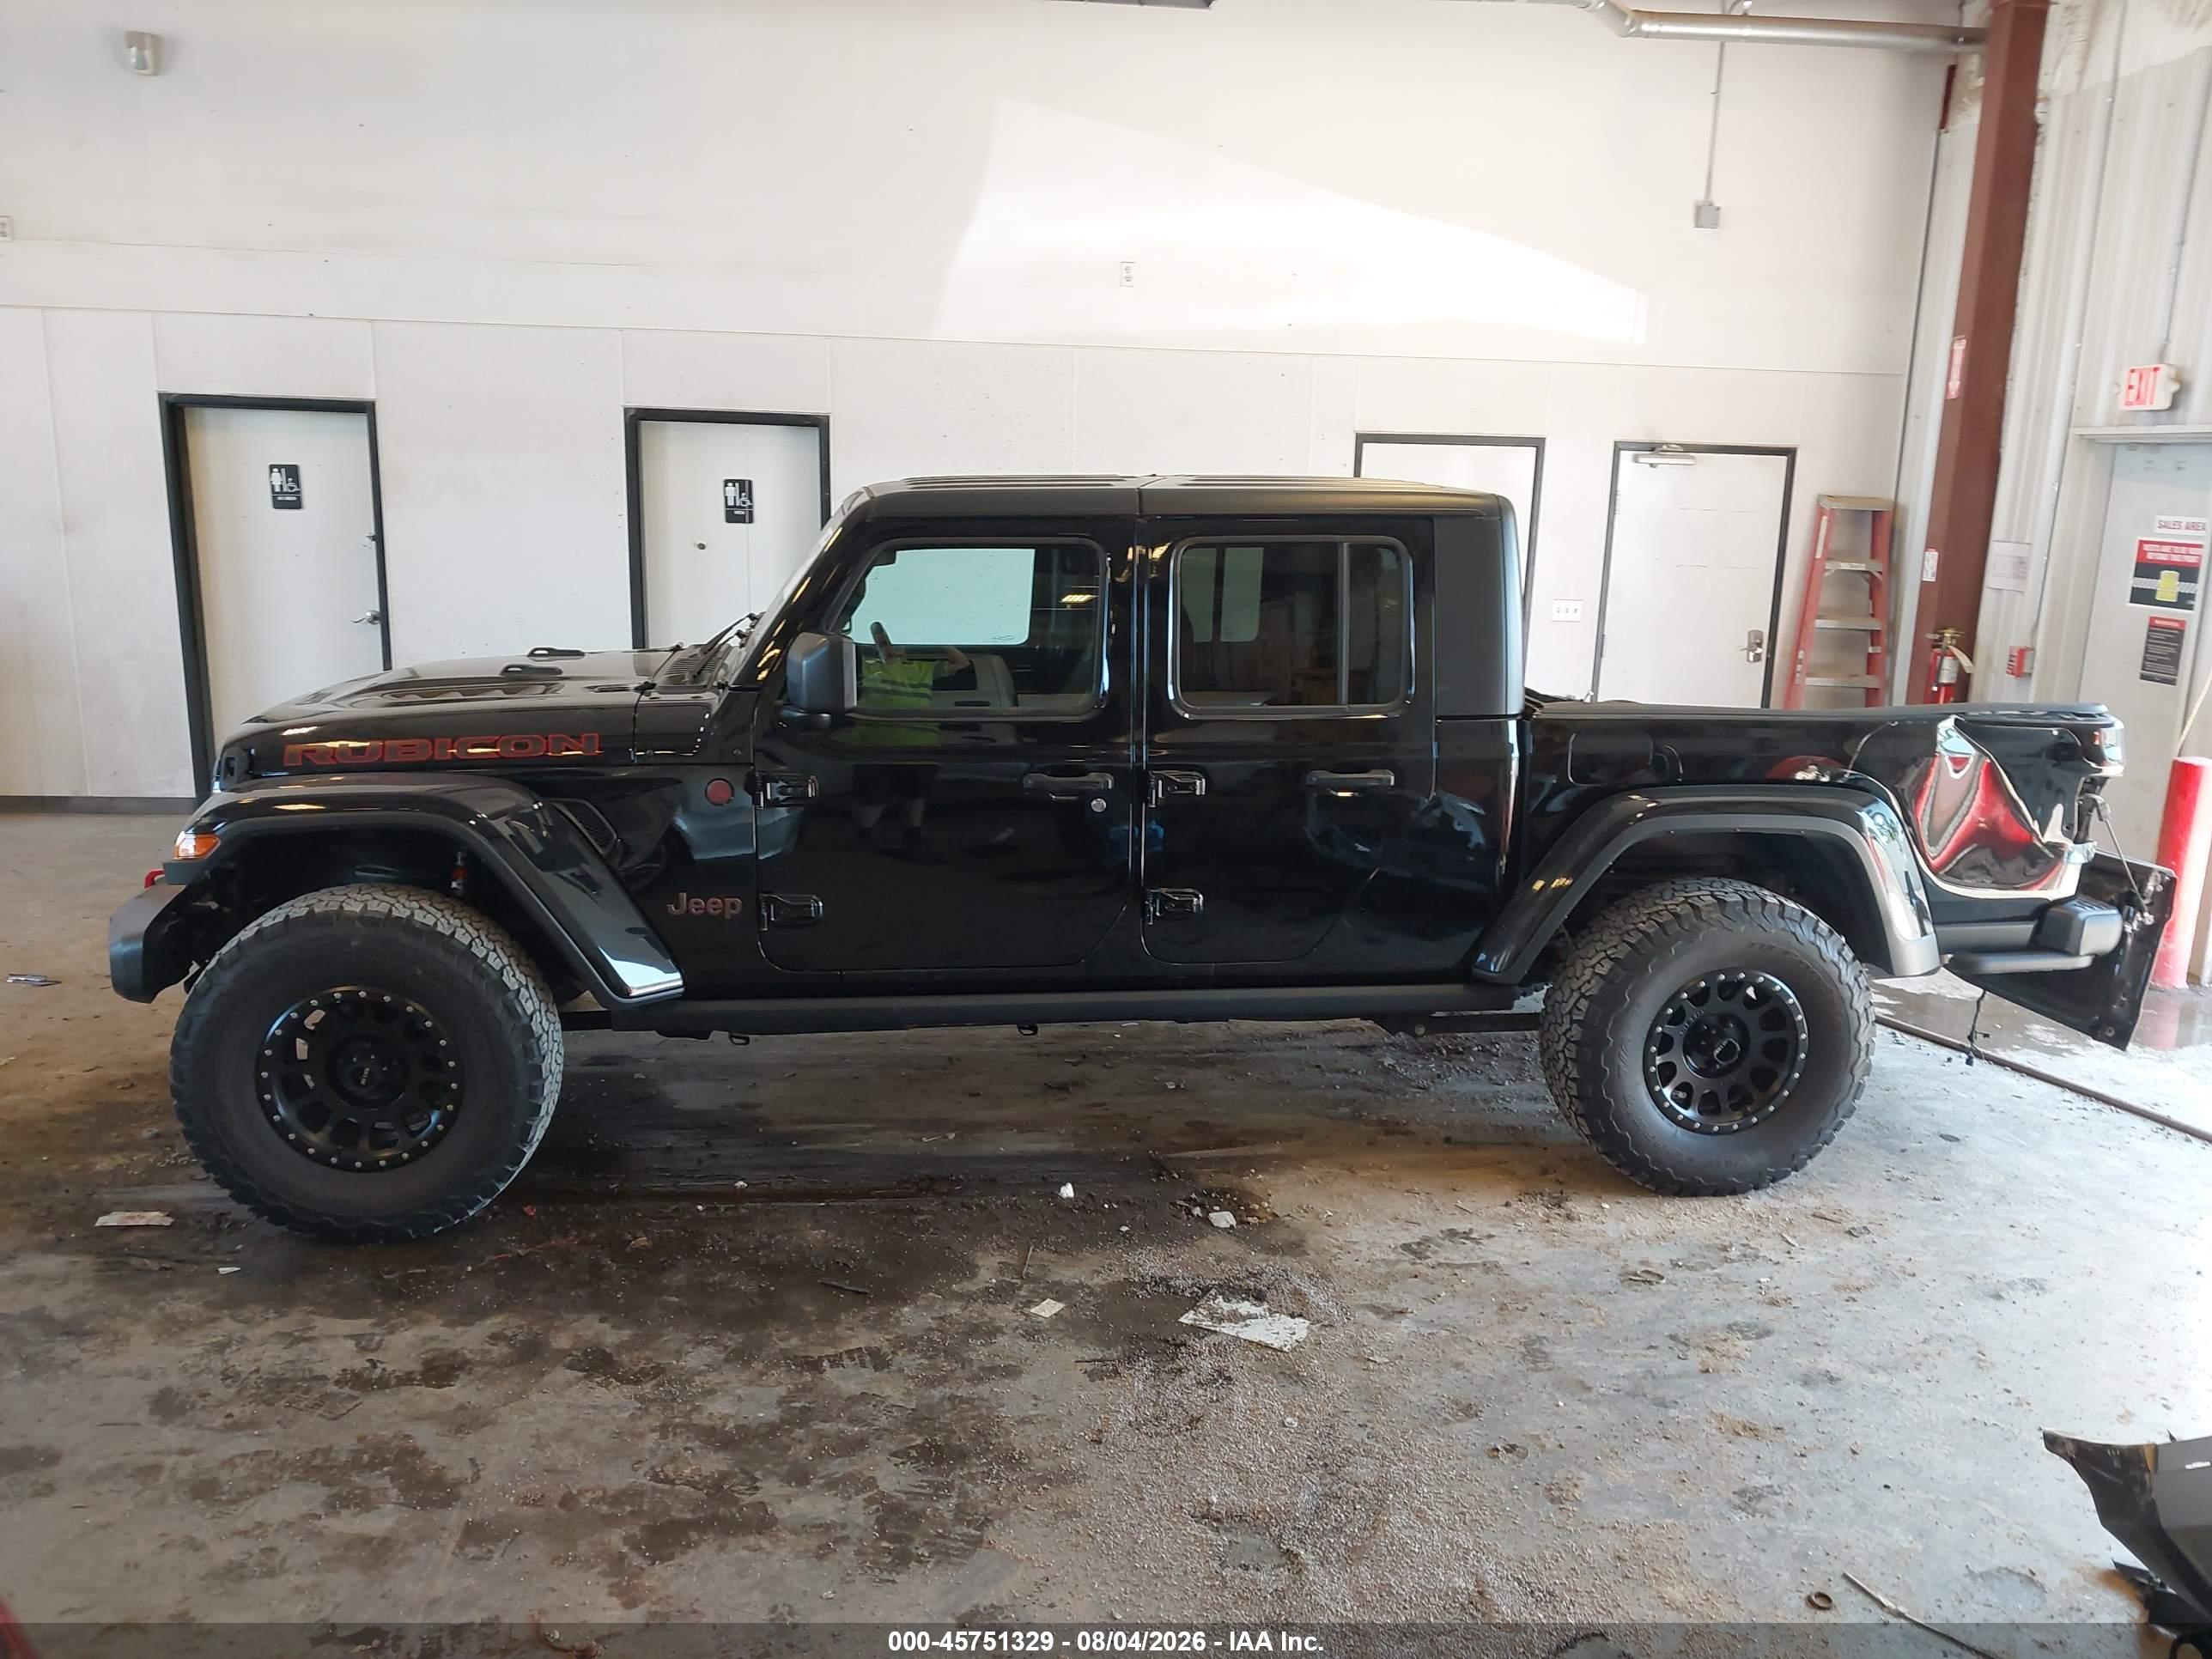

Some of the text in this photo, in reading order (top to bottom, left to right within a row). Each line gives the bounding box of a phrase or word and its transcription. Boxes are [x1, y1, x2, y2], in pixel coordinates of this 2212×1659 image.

[2124, 367, 2161, 406] EXIT
[2157, 520, 2182, 530] SALES
[283, 732, 600, 766] RUBICON
[666, 892, 743, 920] Jeep
